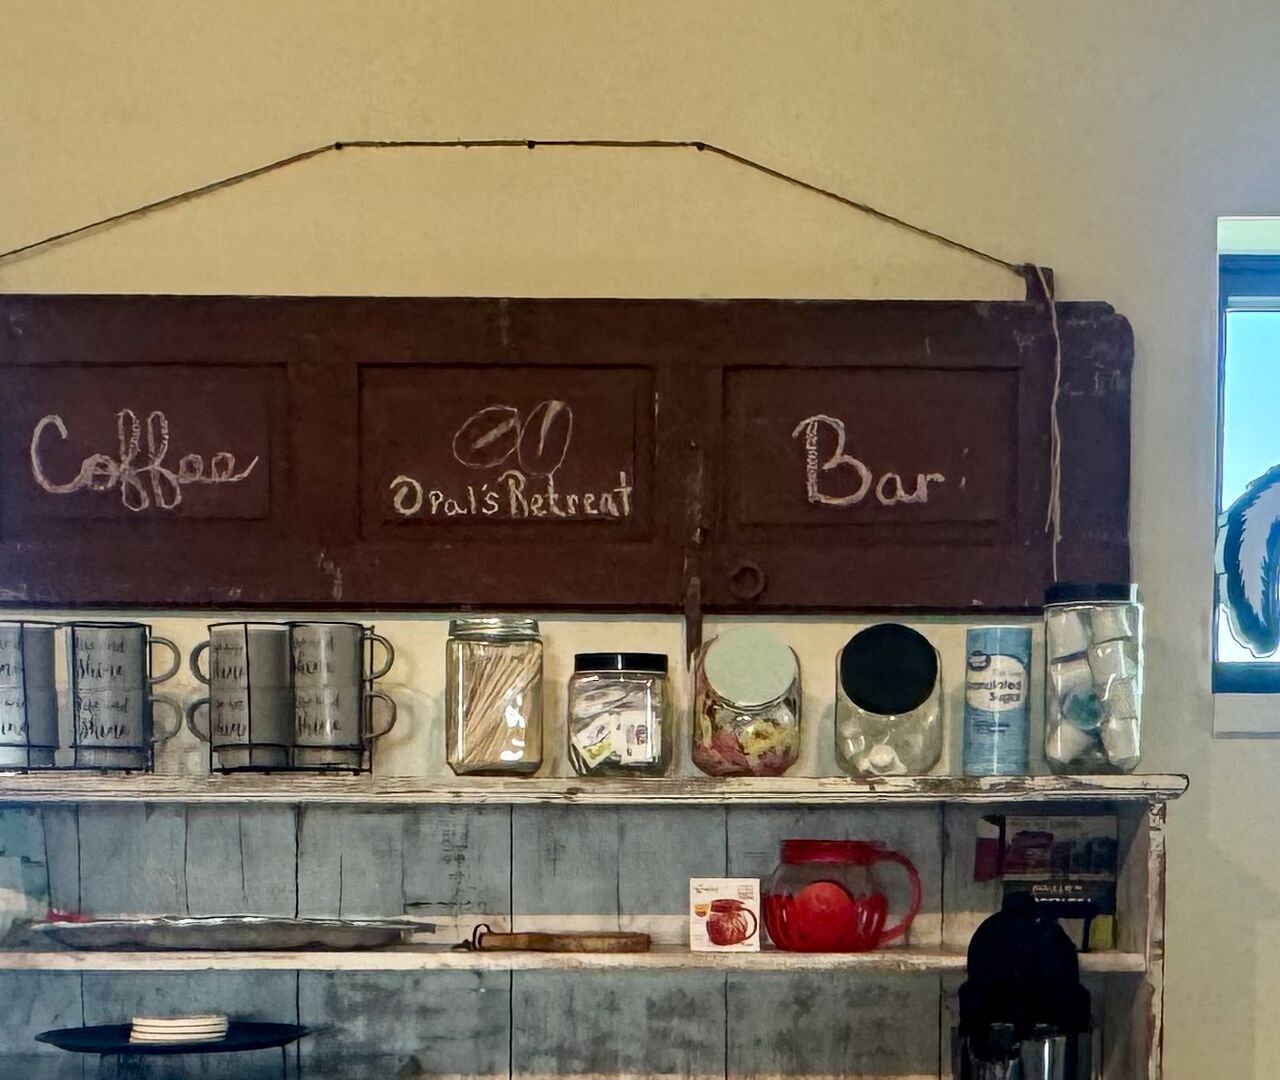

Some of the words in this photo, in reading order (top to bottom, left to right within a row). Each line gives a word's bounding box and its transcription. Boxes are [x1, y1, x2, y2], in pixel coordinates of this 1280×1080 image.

[31, 409, 259, 512] Coffee
[389, 475, 499, 516] Opal's
[497, 469, 633, 518] Retreat
[792, 414, 945, 506] Bar
